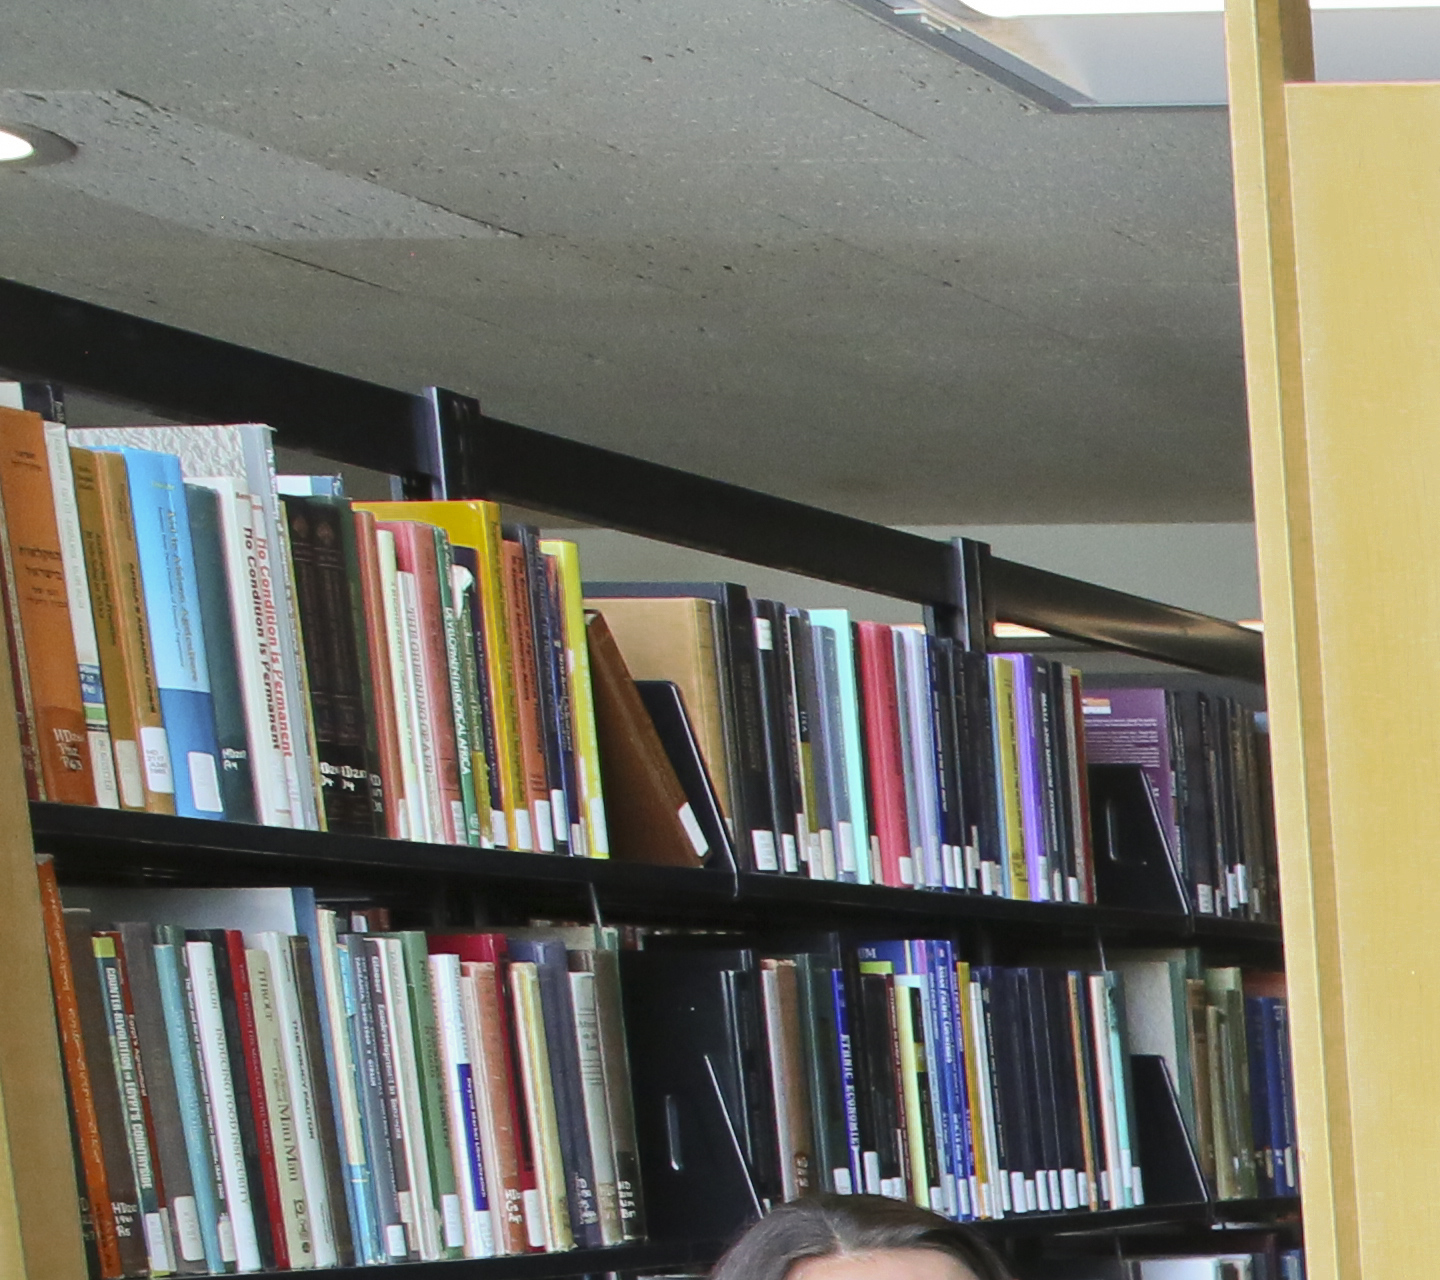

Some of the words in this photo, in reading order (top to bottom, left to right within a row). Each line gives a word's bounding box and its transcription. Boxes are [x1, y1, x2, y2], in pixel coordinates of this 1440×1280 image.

[243, 527, 255, 550] No
[256, 538, 268, 563] No
[248, 555, 268, 637] Condition
[260, 566, 278, 646] Condition
[260, 643, 271, 656] is
[270, 651, 282, 664] is
[262, 660, 281, 750] Permanent
[273, 668, 292, 757] Permanent
[459, 738, 471, 775] AFRICA
[215, 1028, 231, 1091] INDUCING
[840, 1034, 853, 1079] ETHNIC
[124, 1082, 141, 1121] EGYPT'S
[223, 1094, 236, 1130] FOOD
[277, 1104, 292, 1142] Mau
[132, 1123, 152, 1188] COUNTRYSIDE
[228, 1131, 248, 1205] INSECURITY
[282, 1144, 299, 1182] Mau
